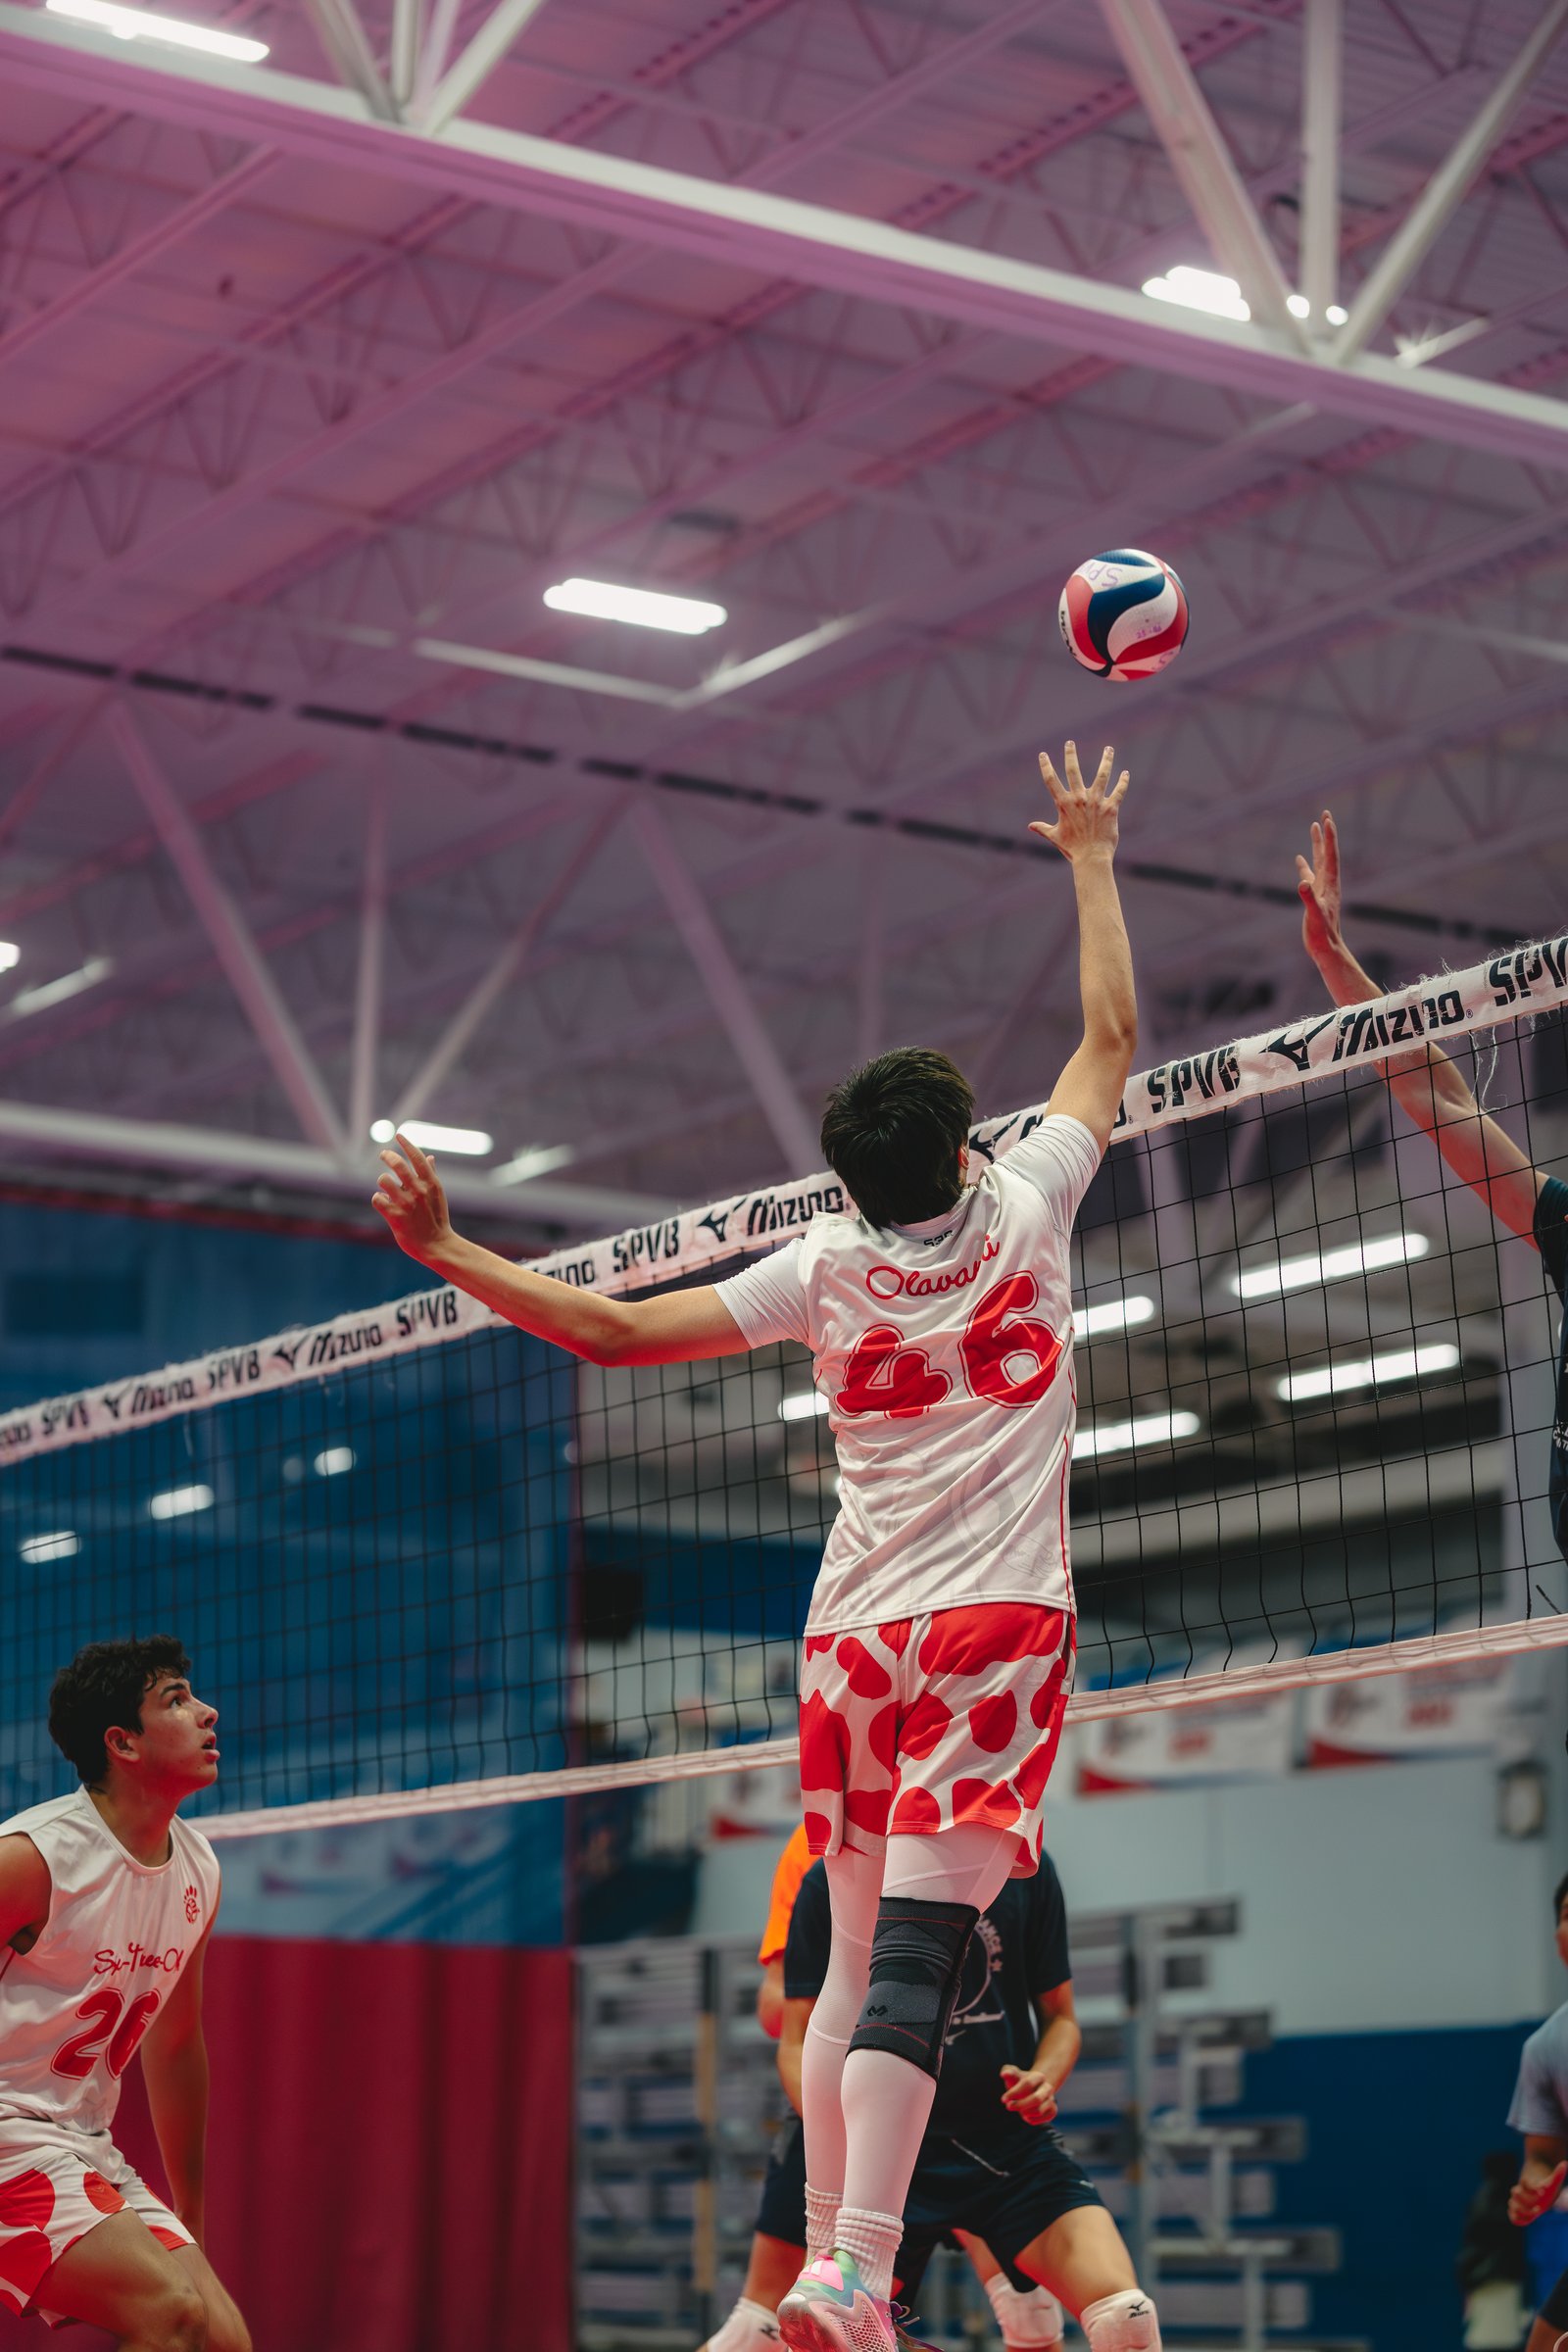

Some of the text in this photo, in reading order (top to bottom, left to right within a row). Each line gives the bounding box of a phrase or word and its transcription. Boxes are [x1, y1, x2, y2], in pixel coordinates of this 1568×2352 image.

[612, 1217, 679, 1273] SPVB
[747, 1185, 845, 1237] Mizuno
[1147, 1046, 1241, 1114] SPVB
[1331, 989, 1465, 1062] Mizuno
